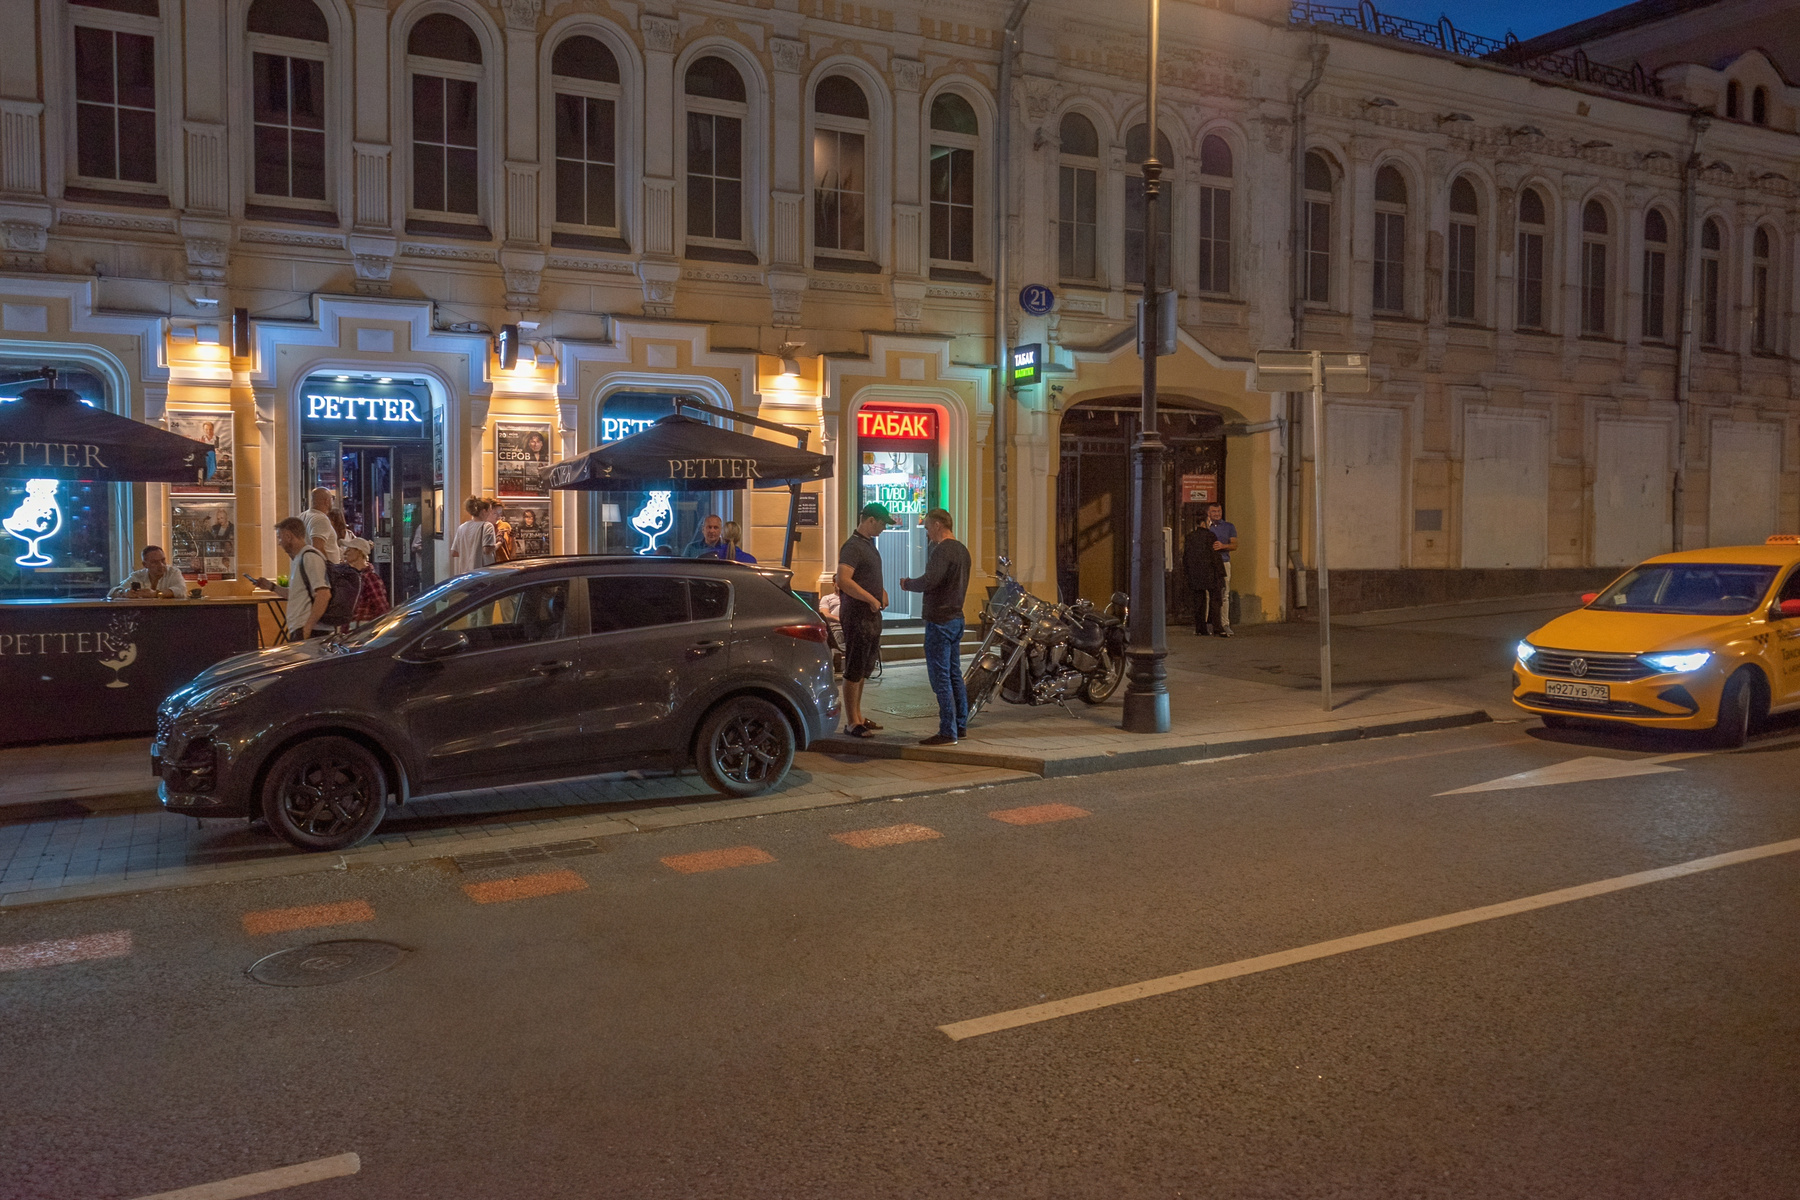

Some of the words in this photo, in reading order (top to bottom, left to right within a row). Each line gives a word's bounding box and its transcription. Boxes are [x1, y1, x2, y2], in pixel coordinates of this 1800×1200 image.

[1030, 289, 1047, 306] 21
[1015, 351, 1034, 367] ТАБАК
[307, 395, 422, 422] PETTER
[857, 413, 928, 437] ТАБАК
[499, 451, 531, 461] СЕРОВ
[667, 458, 763, 479] PETTER
[881, 487, 907, 500] ПИВО
[0, 631, 117, 656] PETTER
[1589, 685, 1606, 696] 799
